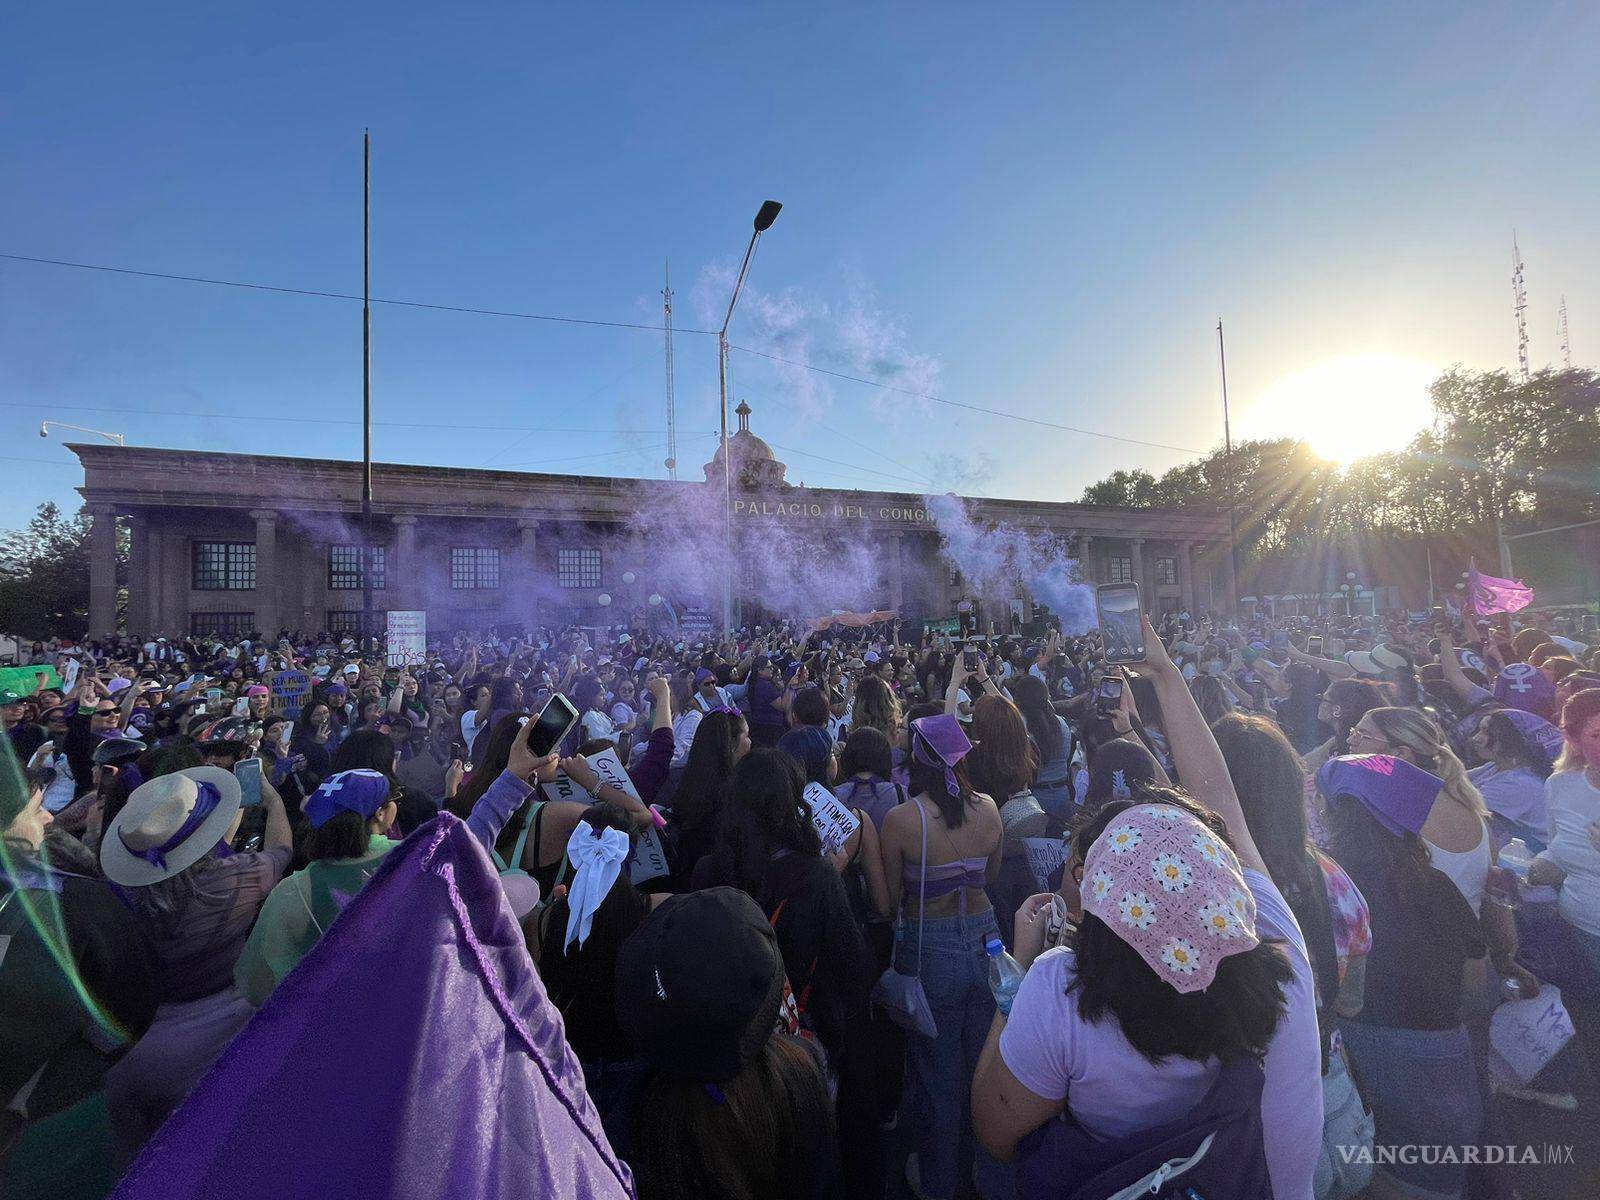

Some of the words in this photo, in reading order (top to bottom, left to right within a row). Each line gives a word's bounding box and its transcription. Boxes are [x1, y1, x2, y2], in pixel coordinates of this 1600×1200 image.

[734, 500, 821, 516] PALACIO
[834, 505, 868, 519] DEL
[388, 652, 427, 667] TODAS
